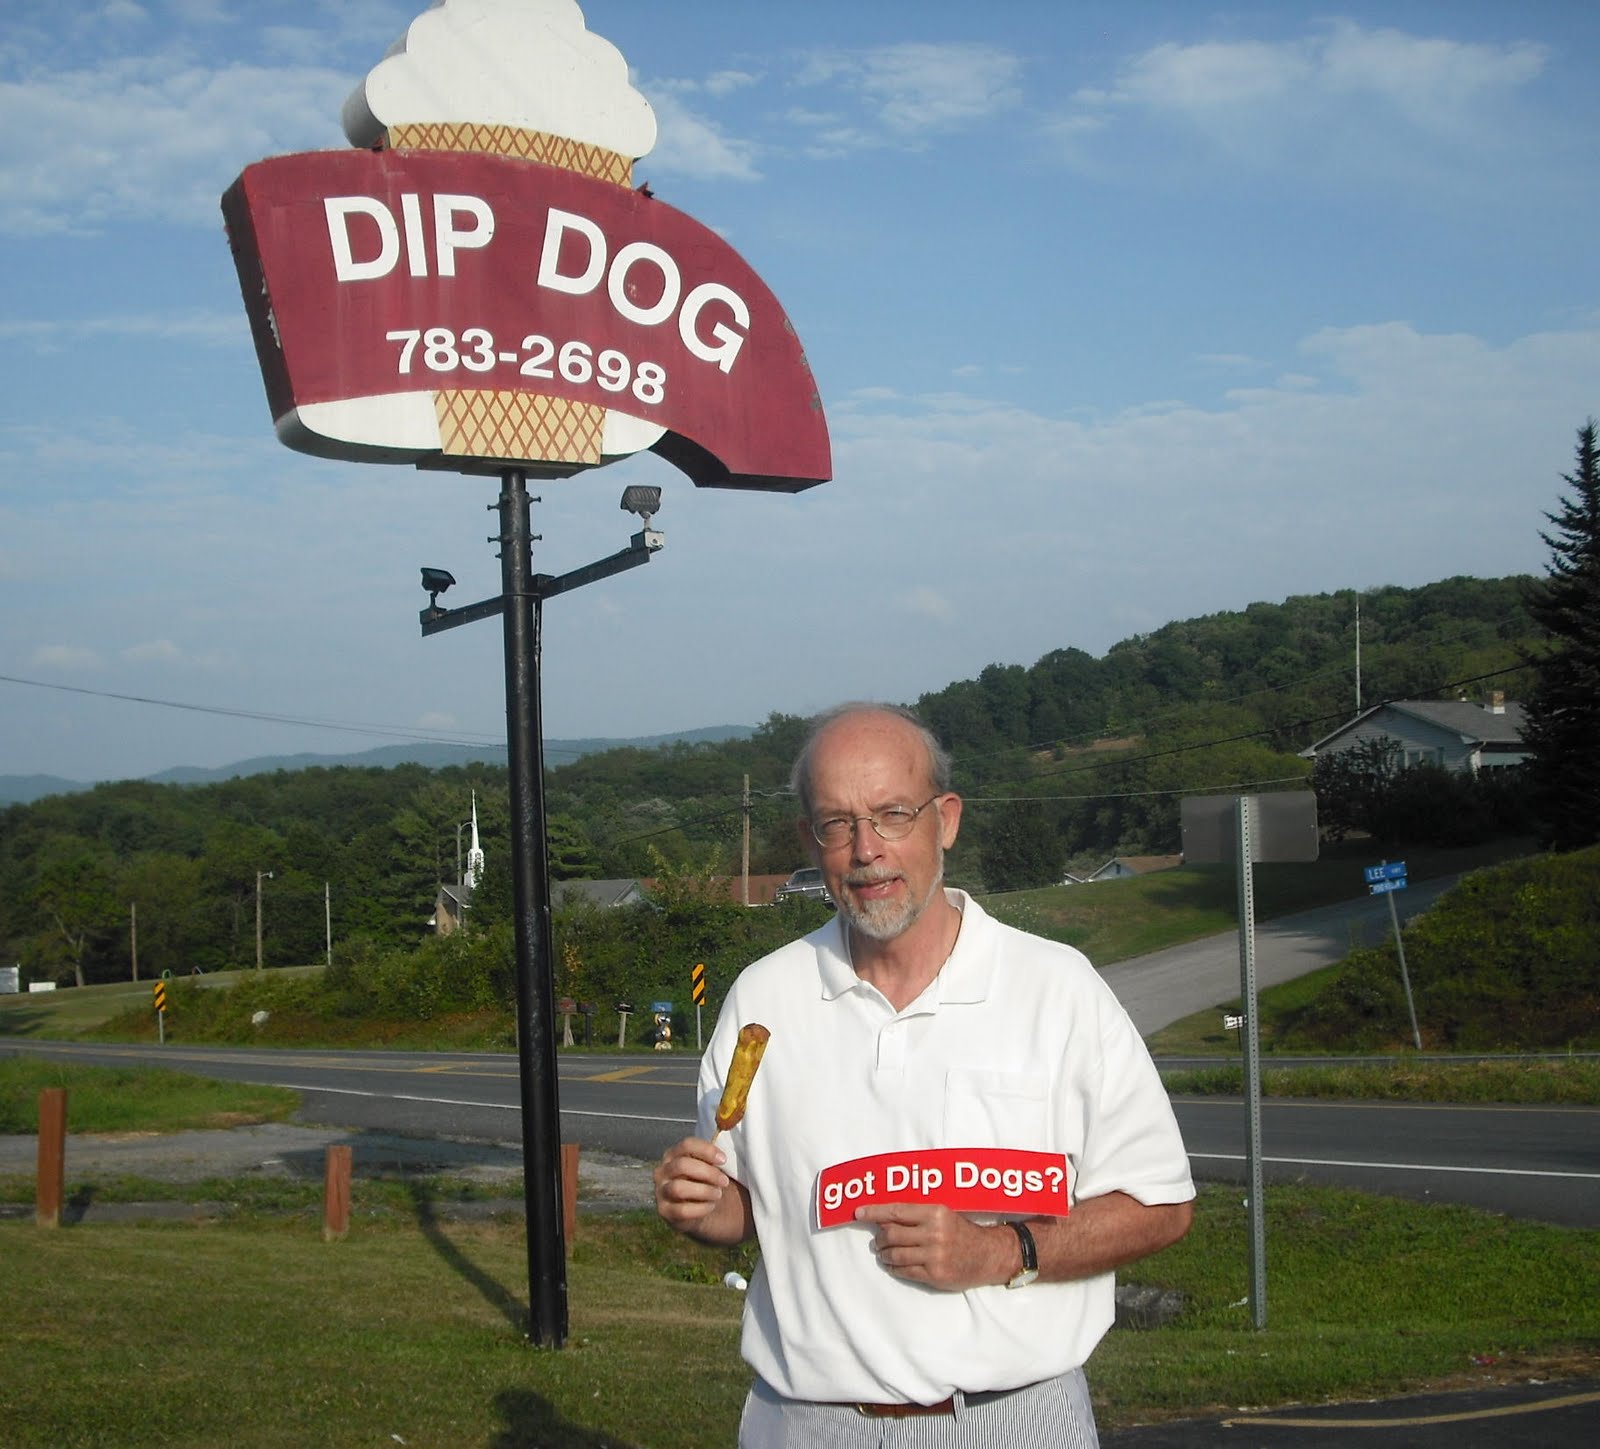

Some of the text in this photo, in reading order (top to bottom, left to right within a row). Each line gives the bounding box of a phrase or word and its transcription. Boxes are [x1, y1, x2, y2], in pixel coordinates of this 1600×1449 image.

[324, 193, 751, 374] DIP DOG
[386, 327, 667, 405] 783-2698
[1368, 867, 1386, 880] LEE
[823, 1161, 1064, 1210] got Dip Dogs?
